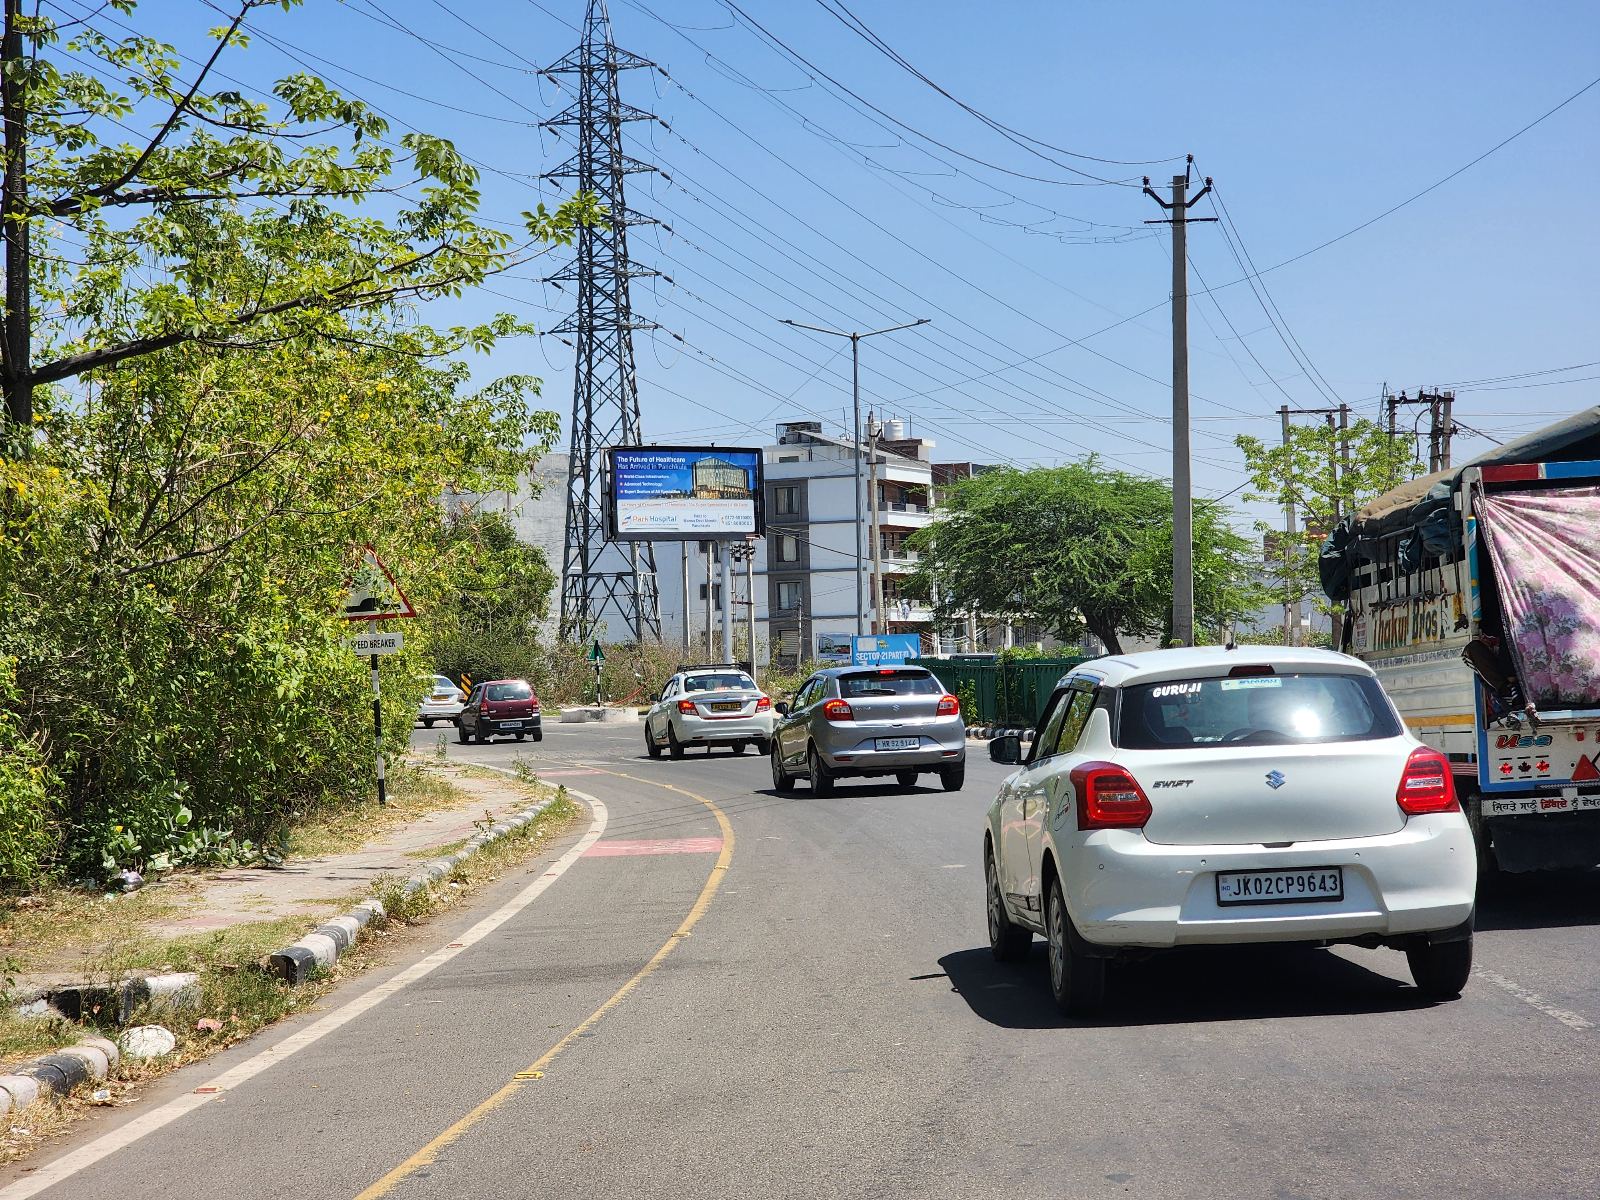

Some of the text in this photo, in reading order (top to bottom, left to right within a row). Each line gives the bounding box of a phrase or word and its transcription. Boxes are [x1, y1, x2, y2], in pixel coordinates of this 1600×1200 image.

[658, 463, 687, 471] Panchkula
[632, 515, 649, 523] Park
[649, 515, 677, 524] Hospital
[369, 638, 396, 649] BREAKER
[1152, 682, 1203, 698] GURUJI
[1152, 779, 1194, 789] SWIFT
[1232, 873, 1339, 896] JK02CP9643
